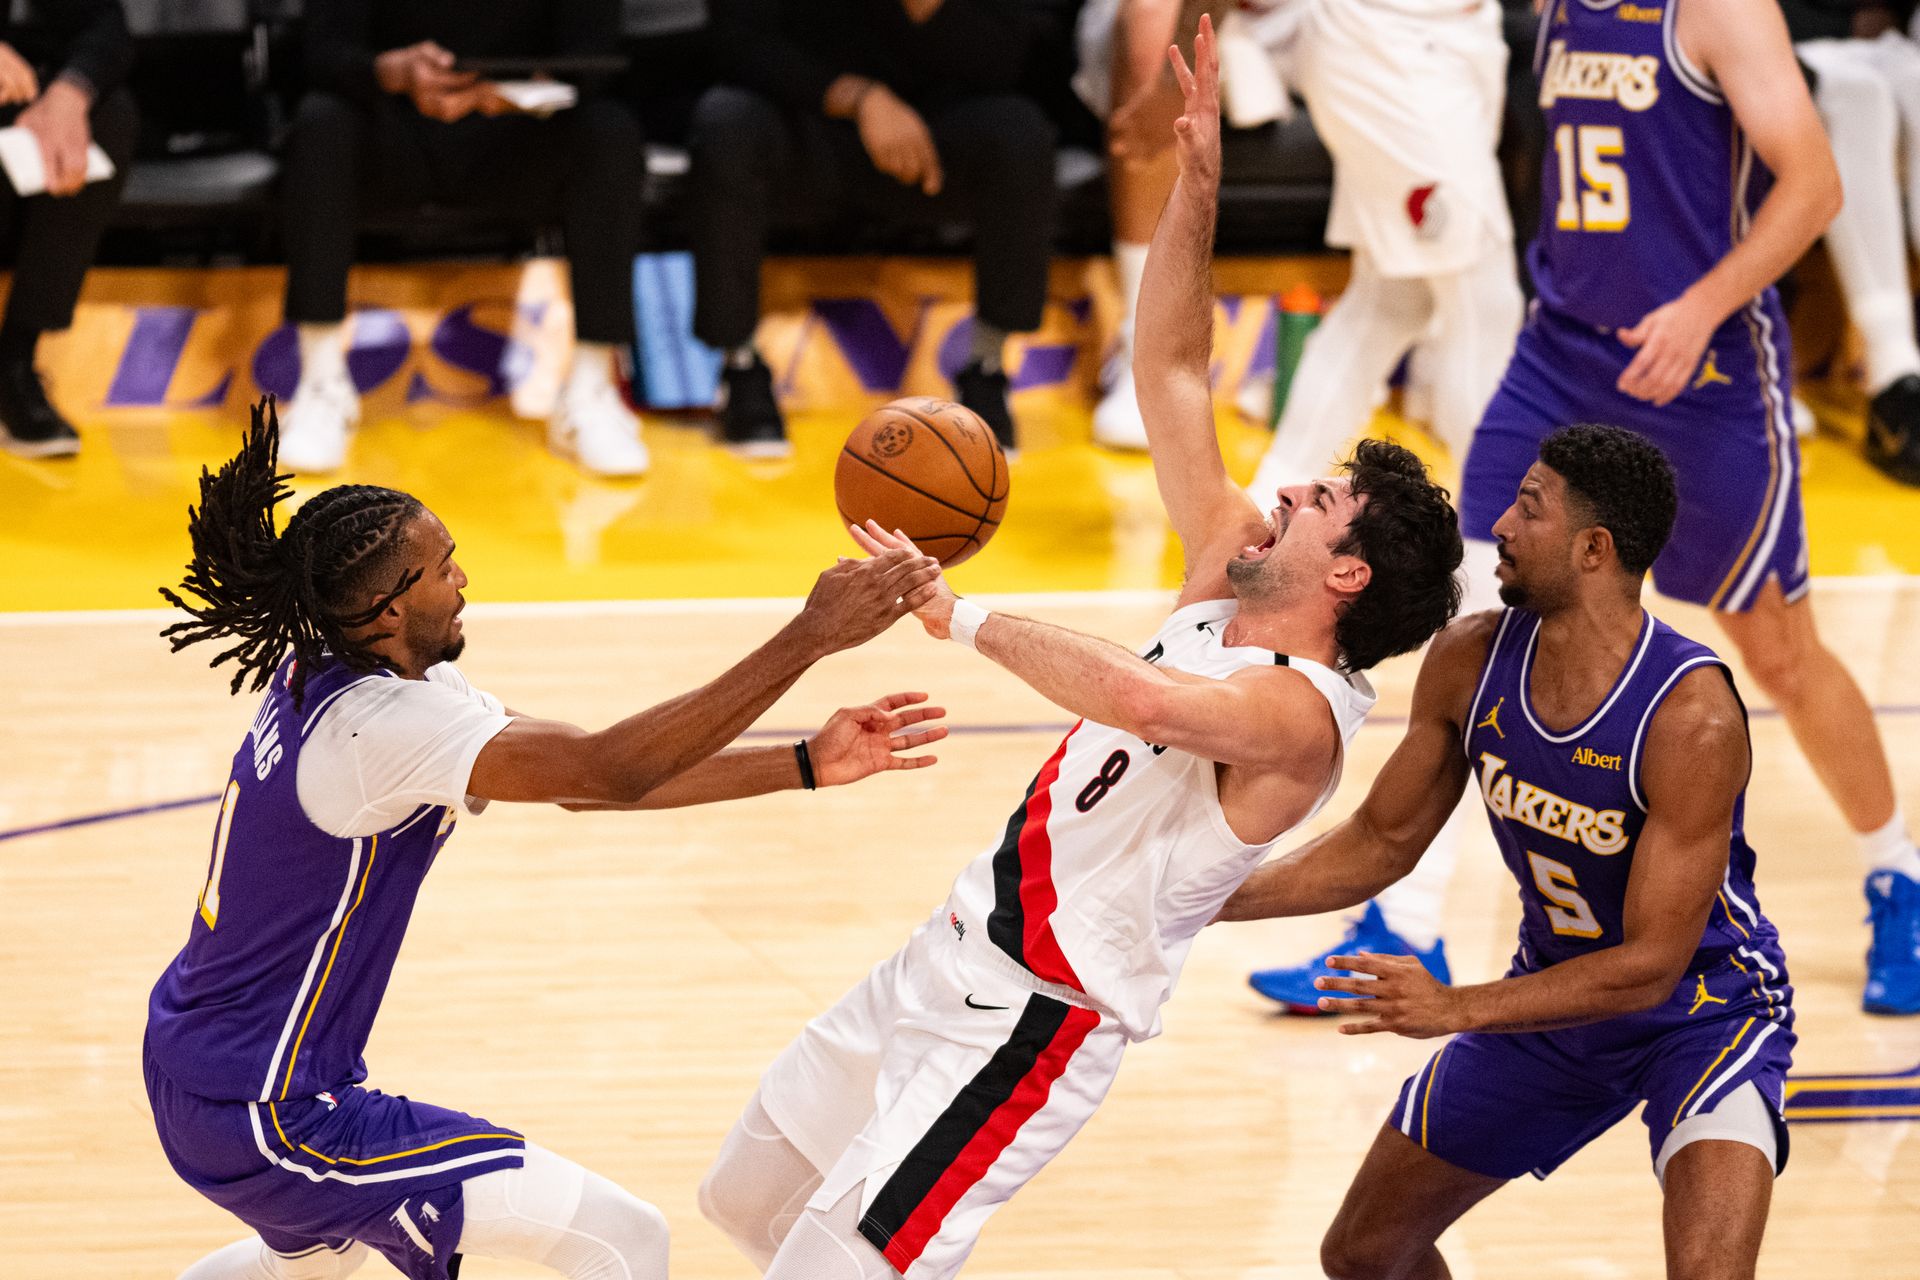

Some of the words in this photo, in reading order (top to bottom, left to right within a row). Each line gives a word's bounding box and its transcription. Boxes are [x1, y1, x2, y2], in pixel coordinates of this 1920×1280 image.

[1538, 39, 1660, 111] LAKERS
[1555, 123, 1630, 232] 15
[1075, 749, 1130, 813] 8
[1571, 746, 1623, 771] Albert
[1479, 751, 1630, 856] LAKERS
[1526, 850, 1604, 940] 5
